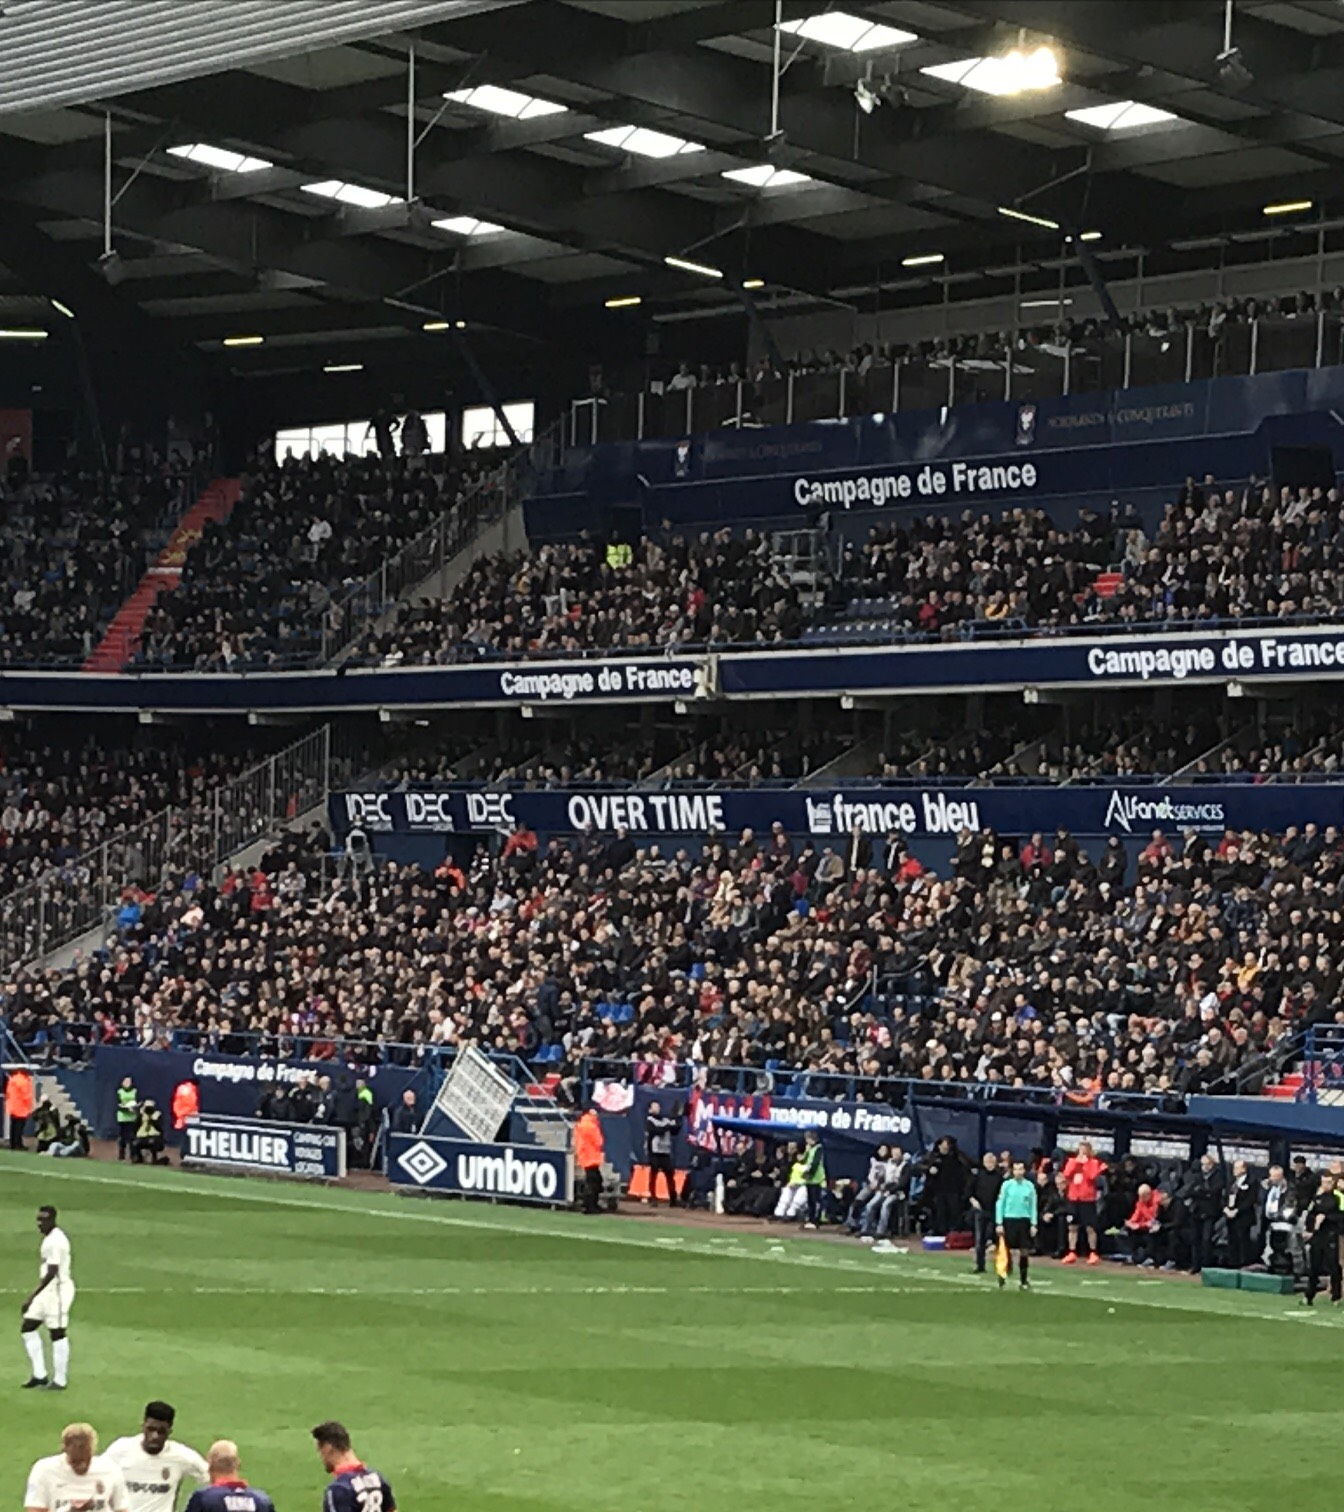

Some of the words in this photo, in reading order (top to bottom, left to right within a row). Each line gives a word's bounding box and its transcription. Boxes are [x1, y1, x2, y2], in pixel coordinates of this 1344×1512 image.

[794, 473, 911, 508] Campagne
[917, 466, 946, 495] de
[952, 462, 1036, 491] France
[1088, 647, 1215, 680] Campagne
[1222, 640, 1254, 669] de
[501, 671, 594, 699] Campagne
[598, 667, 622, 691] de
[626, 666, 692, 689] France
[405, 793, 452, 822] IDEC
[466, 793, 515, 822] IDEC
[834, 793, 916, 833] france
[922, 792, 980, 832] bleu
[193, 1058, 255, 1083] Campagne
[256, 1062, 274, 1081] de
[832, 1107, 851, 1129] de
[854, 1109, 912, 1134] France
[187, 1128, 289, 1165] THELLIER
[458, 1149, 557, 1198] umbro
